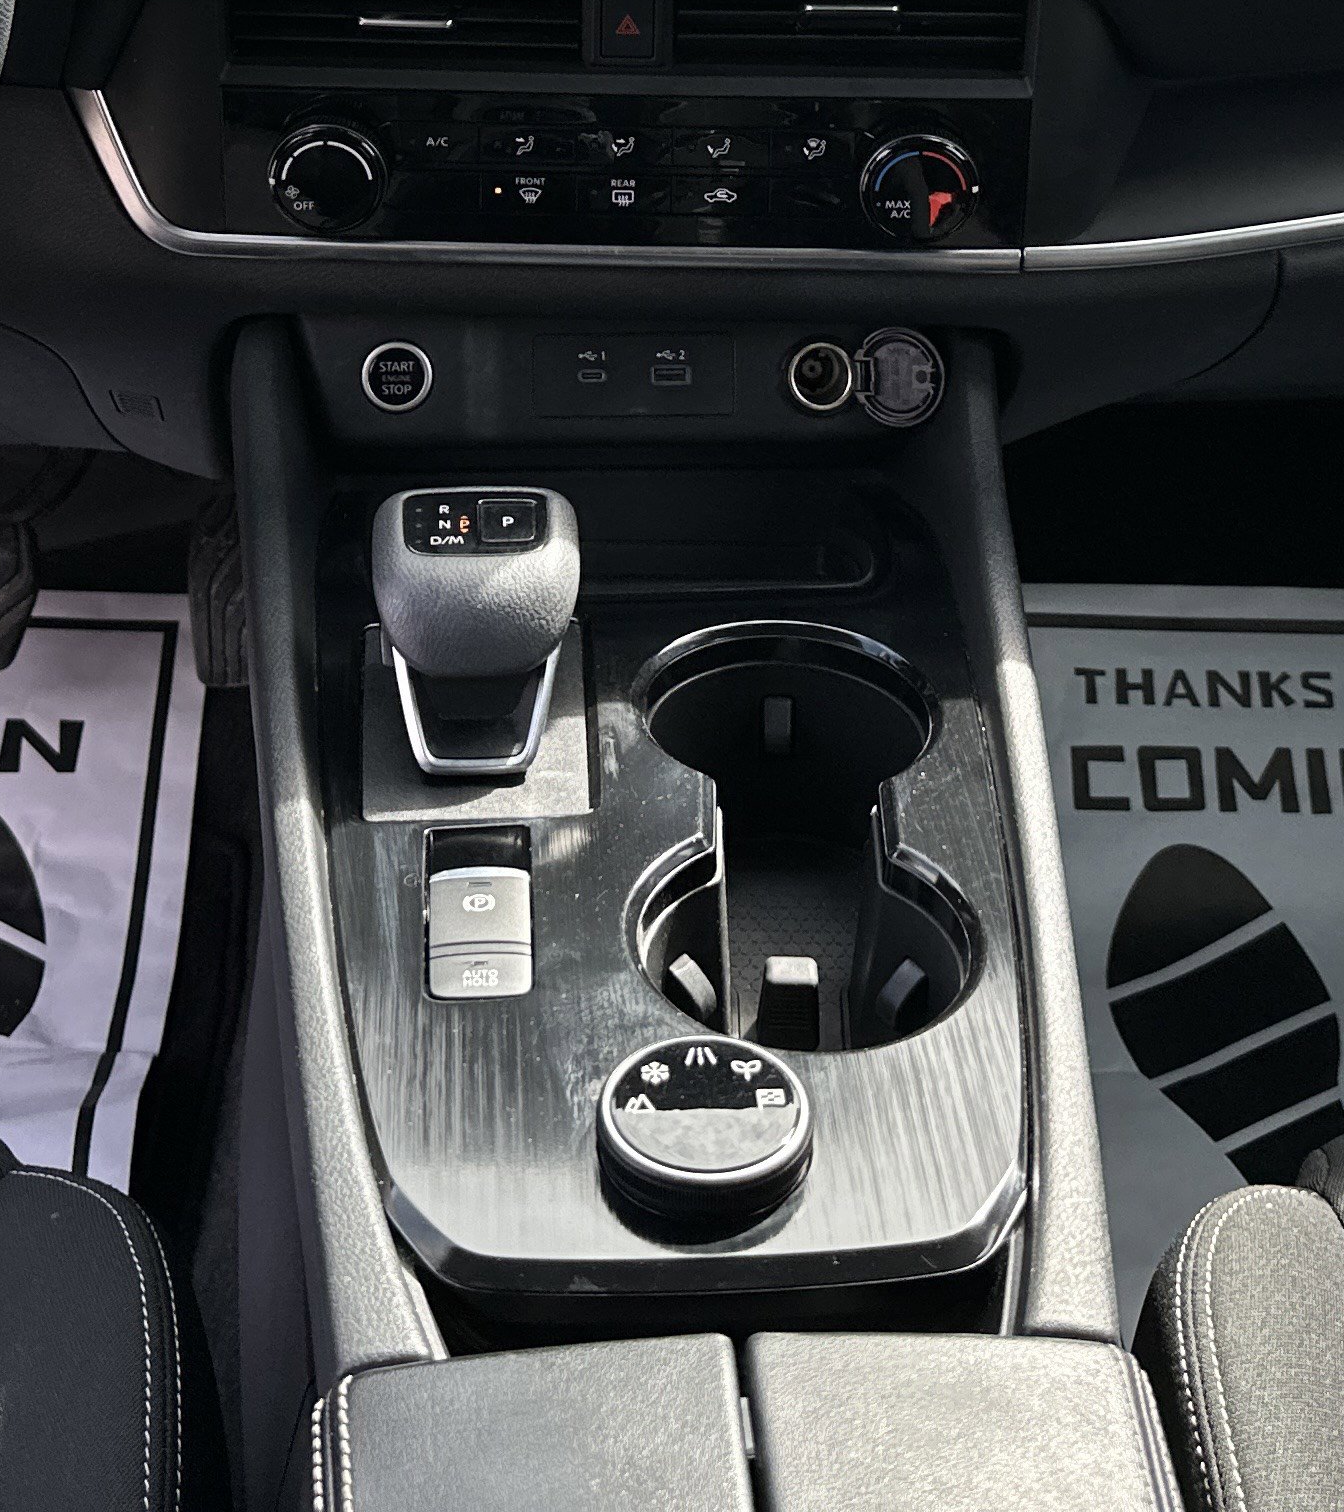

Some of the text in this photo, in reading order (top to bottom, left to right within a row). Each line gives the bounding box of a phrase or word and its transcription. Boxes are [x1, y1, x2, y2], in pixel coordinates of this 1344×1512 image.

[426, 136, 449, 147] A/C
[515, 177, 546, 186] FRONT
[610, 179, 636, 188] REAR
[293, 201, 315, 211] OFF
[885, 200, 911, 209] MAX
[890, 210, 911, 219] A/C
[678, 349, 686, 360] 2
[378, 361, 416, 372] START
[381, 384, 413, 395] STOP
[439, 505, 449, 514] R
[439, 520, 451, 529] N
[502, 516, 514, 527] P
[430, 536, 464, 545] D/M
[1074, 667, 1335, 708] THANKS
[463, 969, 498, 978] AUTO
[463, 977, 498, 987] HOLD
